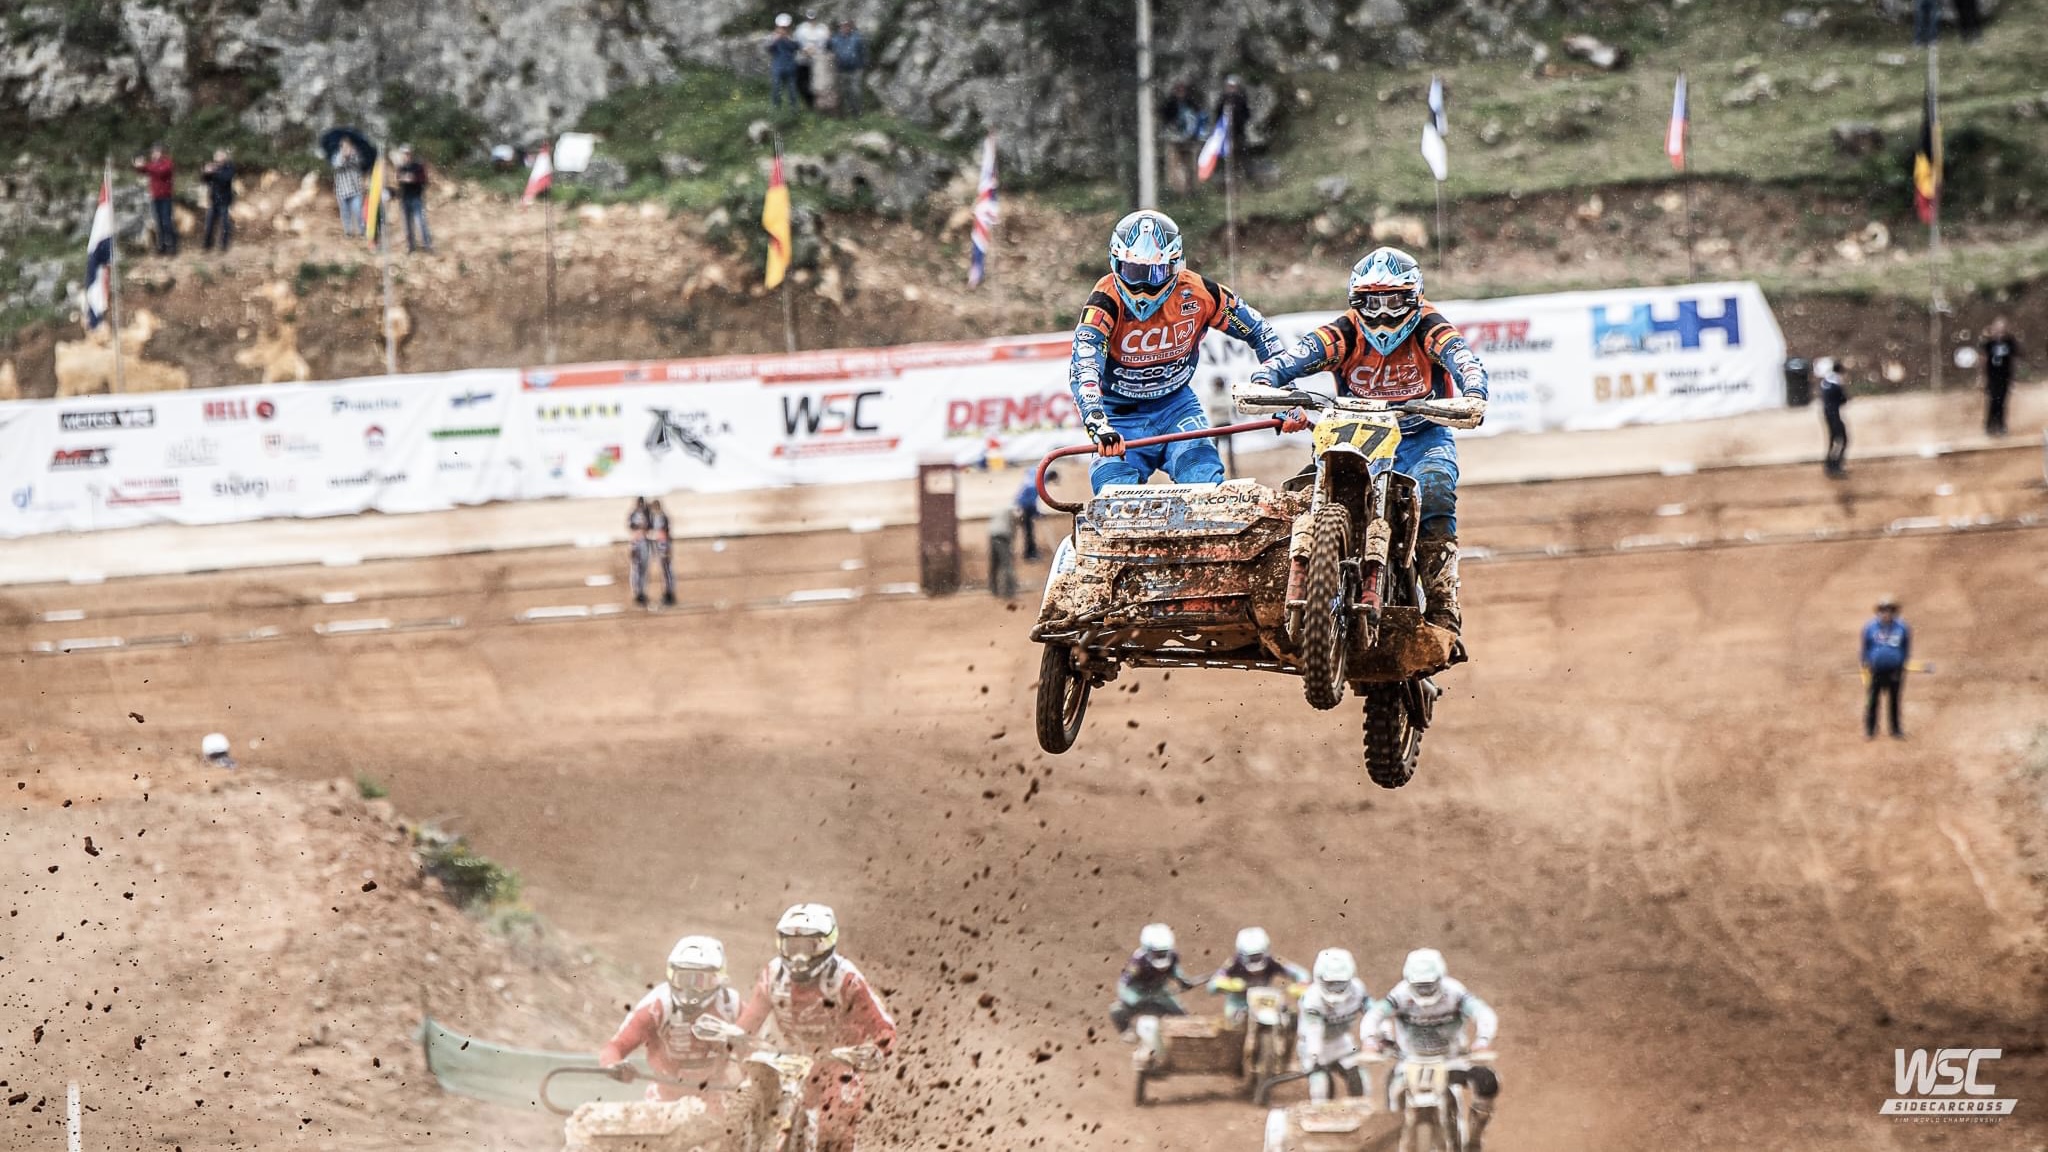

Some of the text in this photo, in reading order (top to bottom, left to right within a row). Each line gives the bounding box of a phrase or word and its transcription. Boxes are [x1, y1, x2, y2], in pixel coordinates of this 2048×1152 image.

[1121, 326, 1173, 354] CCL
[781, 390, 883, 435] WSC
[1330, 422, 1392, 457] 17
